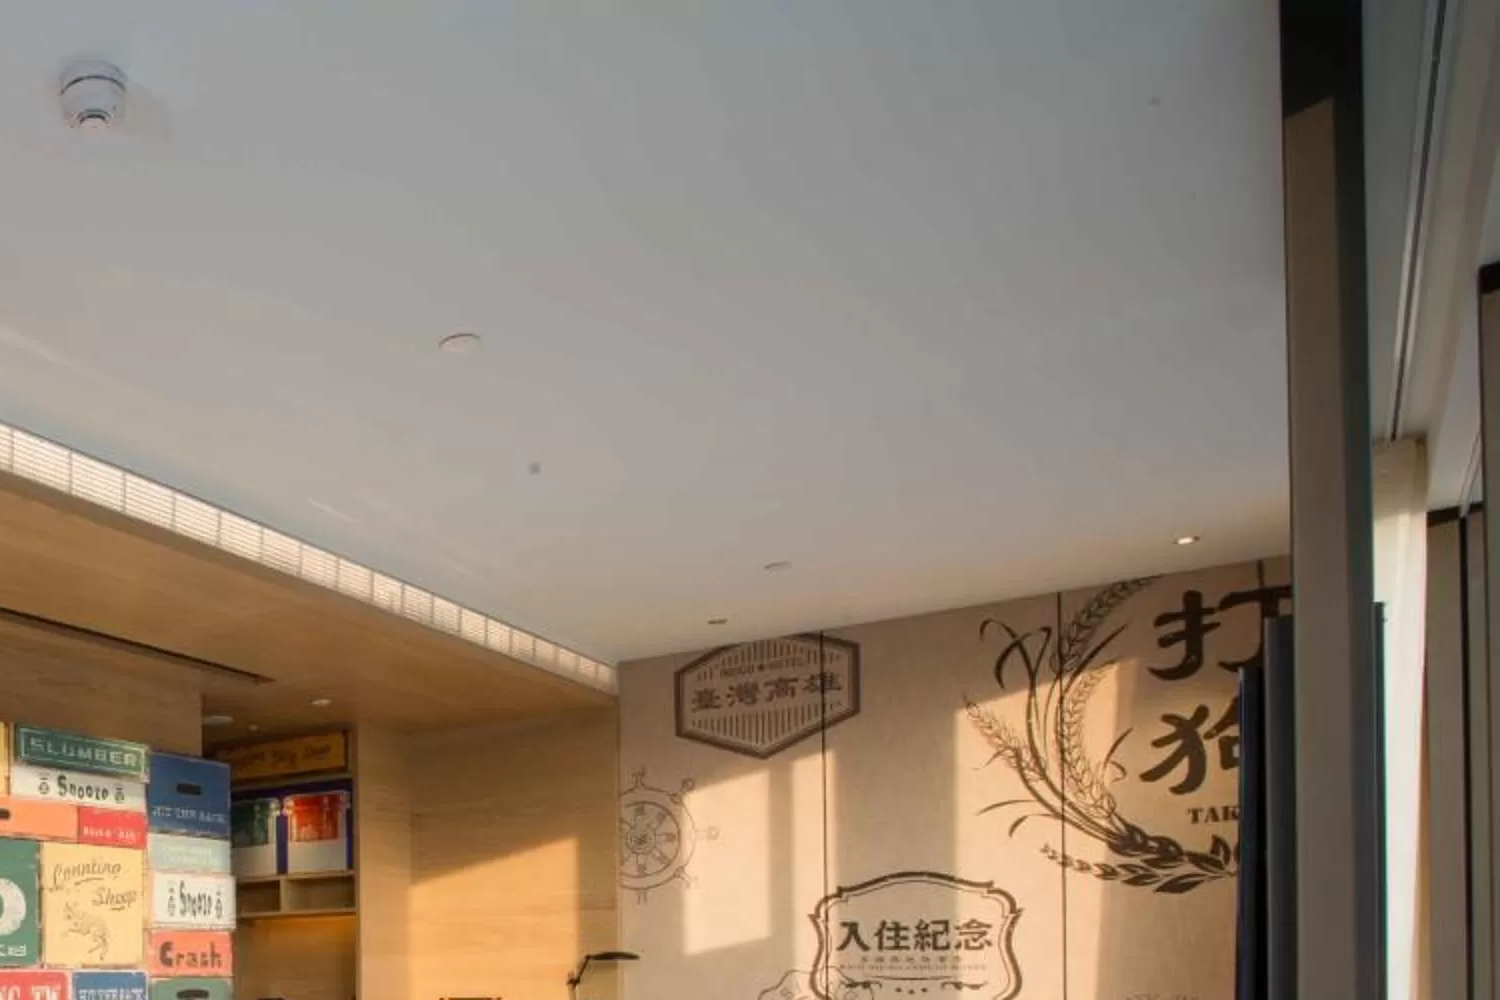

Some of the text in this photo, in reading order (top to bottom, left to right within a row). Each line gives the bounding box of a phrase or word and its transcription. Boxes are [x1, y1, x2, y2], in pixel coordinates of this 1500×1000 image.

[29, 736, 138, 767] SLUMBER
[1186, 805, 1240, 825] TAK
[836, 918, 994, 952] 入住紀念
